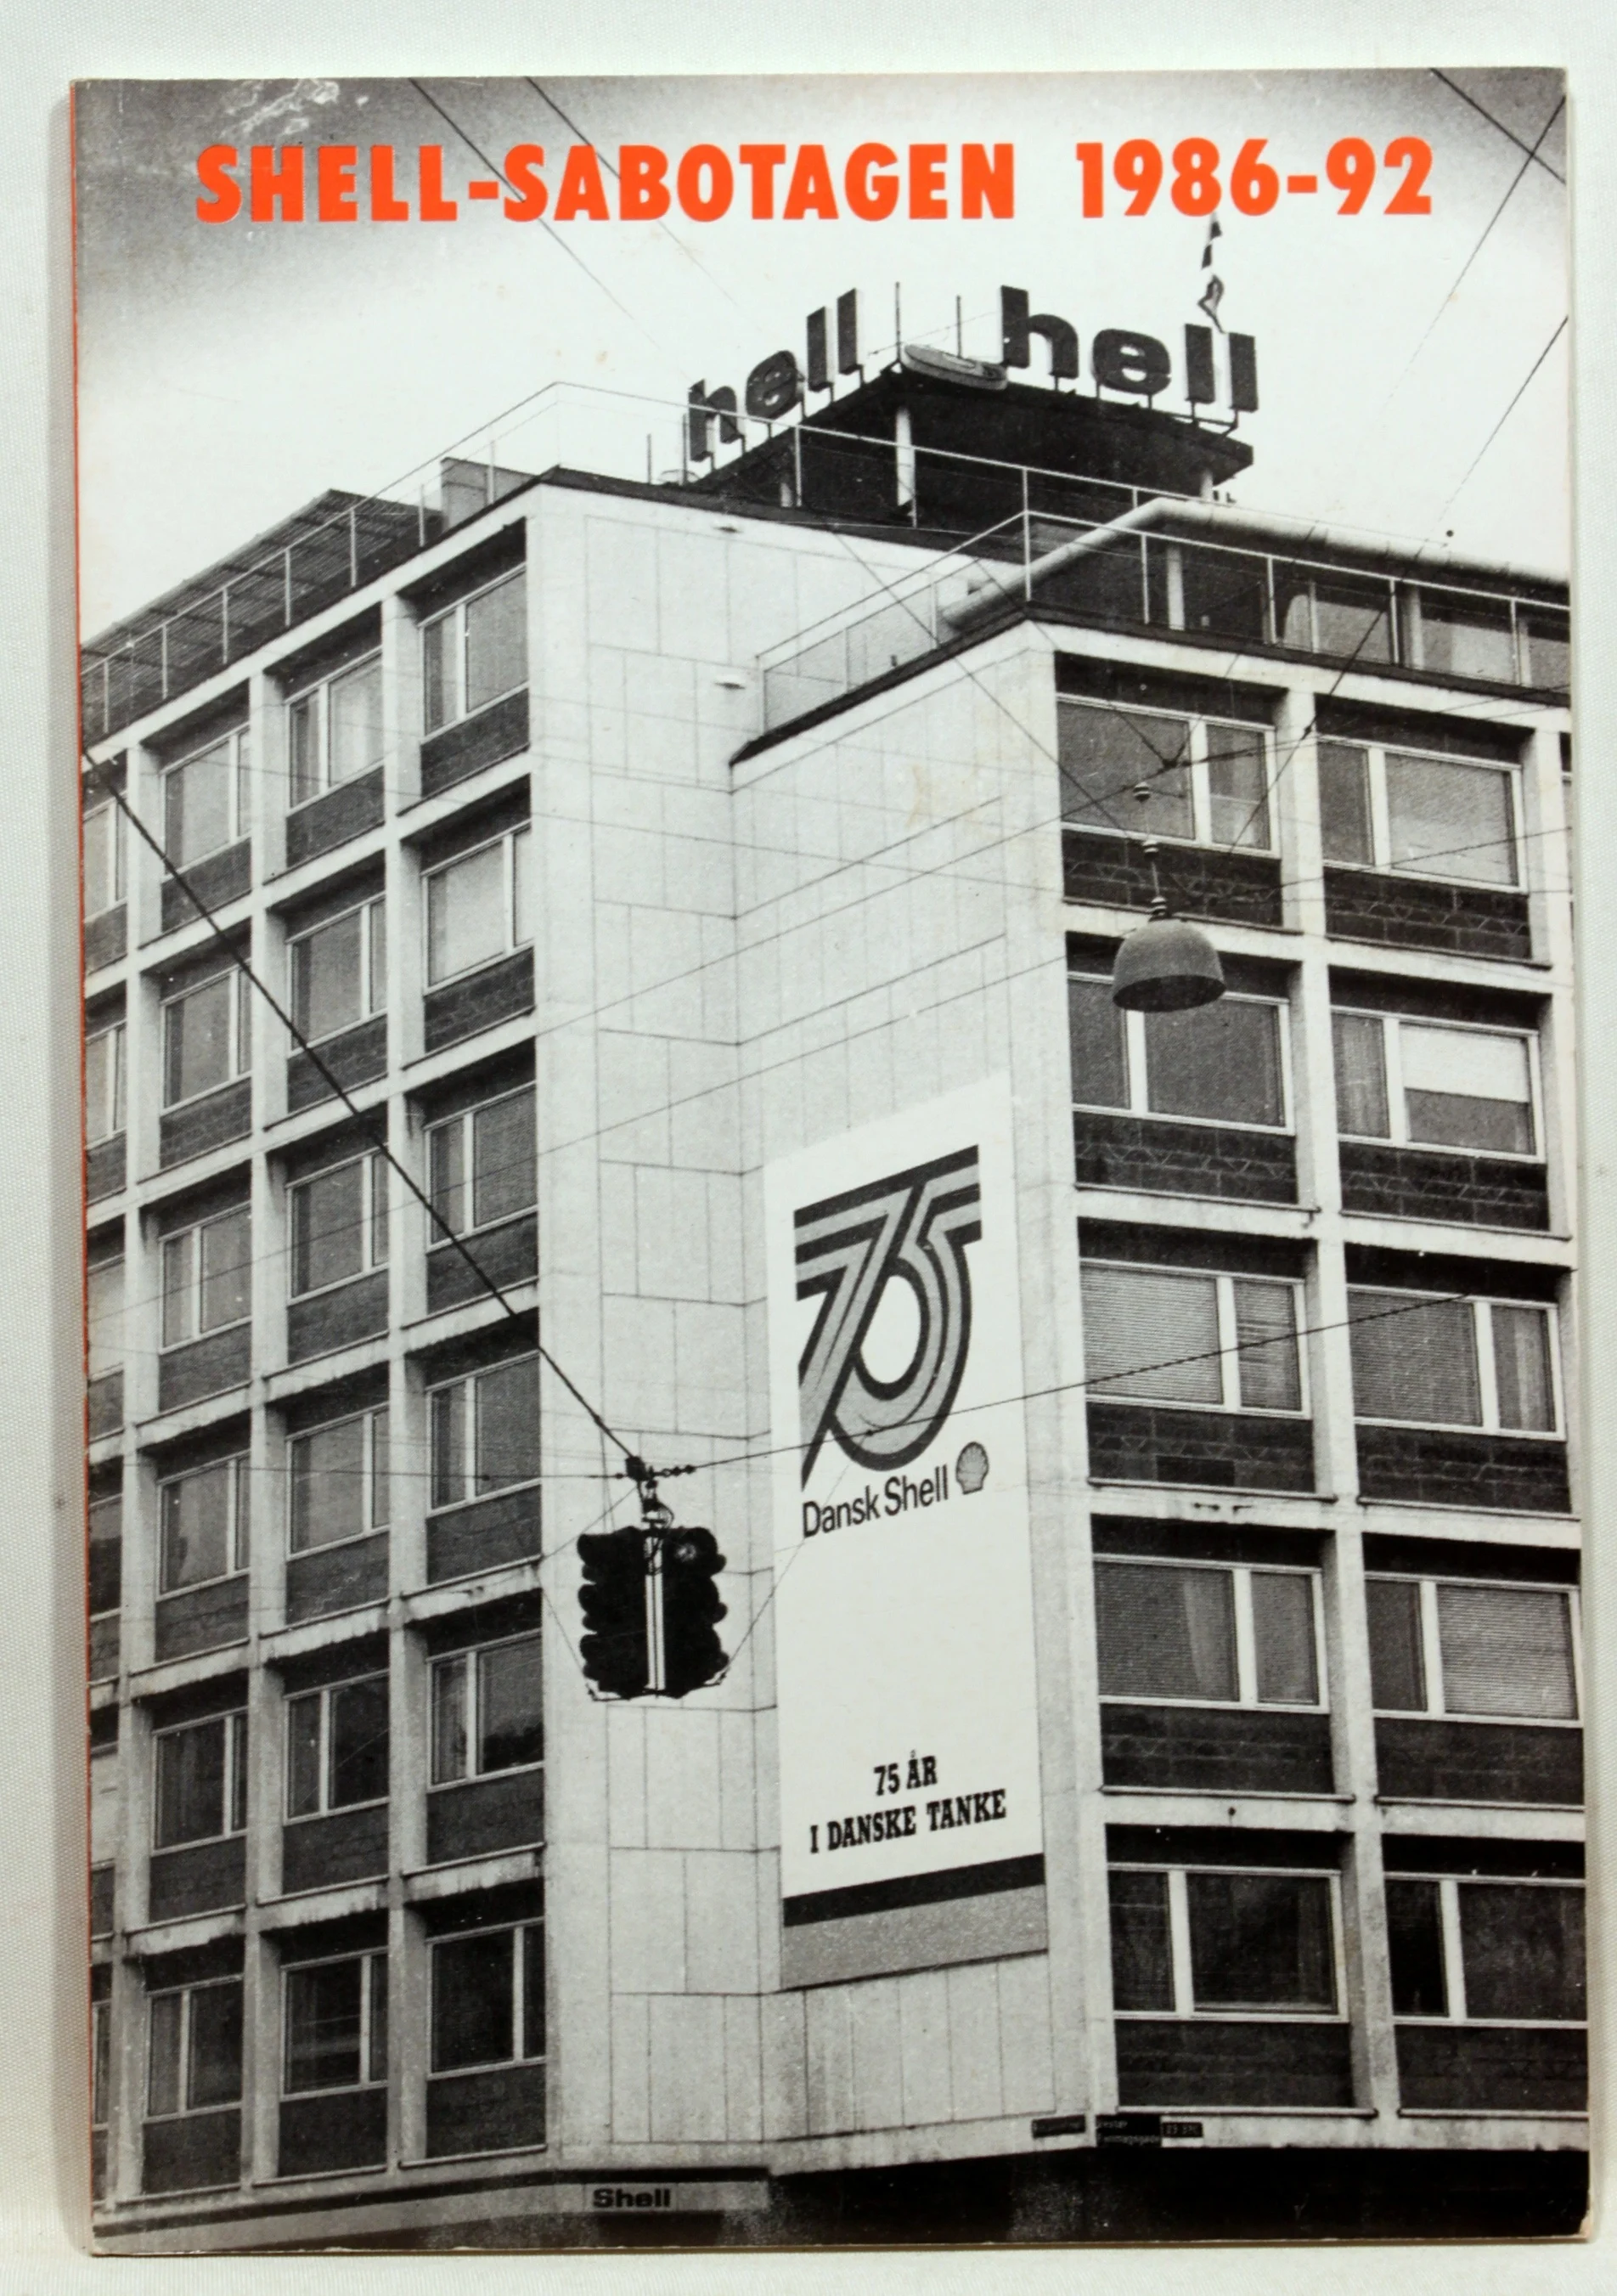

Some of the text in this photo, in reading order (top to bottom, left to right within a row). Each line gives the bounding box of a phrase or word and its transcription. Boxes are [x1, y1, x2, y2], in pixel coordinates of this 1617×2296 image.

[196, 136, 1433, 223] SHELL-SABOTAGEN 1986-92
[1000, 285, 1259, 412] hell
[802, 1464, 949, 1539] Dansk Shell
[873, 1749, 938, 1797] 75 ÅR
[809, 1788, 1007, 1854] I DANSKE TANKE
[593, 2187, 672, 2209] Shell
